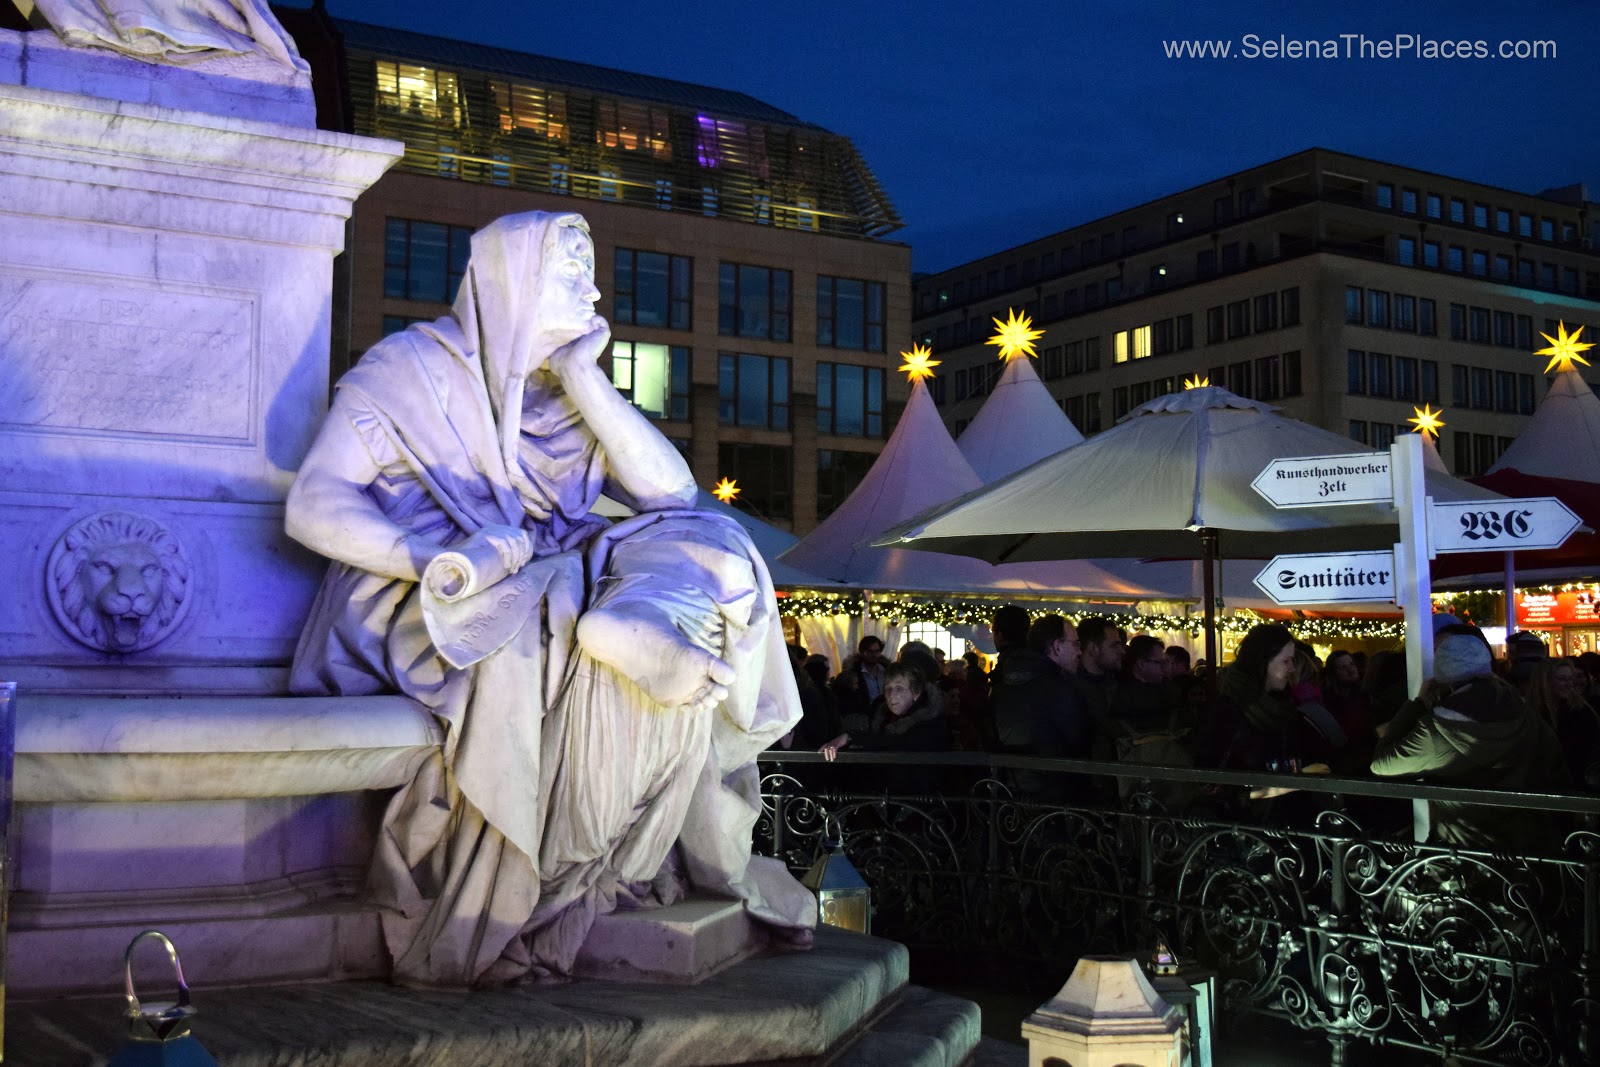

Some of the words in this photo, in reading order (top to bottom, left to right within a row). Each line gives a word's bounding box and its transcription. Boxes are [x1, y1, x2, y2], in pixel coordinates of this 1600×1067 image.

[1276, 463, 1389, 480] Kunsthandwerker
[1318, 480, 1347, 497] Zelt
[1459, 509, 1534, 540] WC
[1277, 566, 1390, 590] Sanitäter
